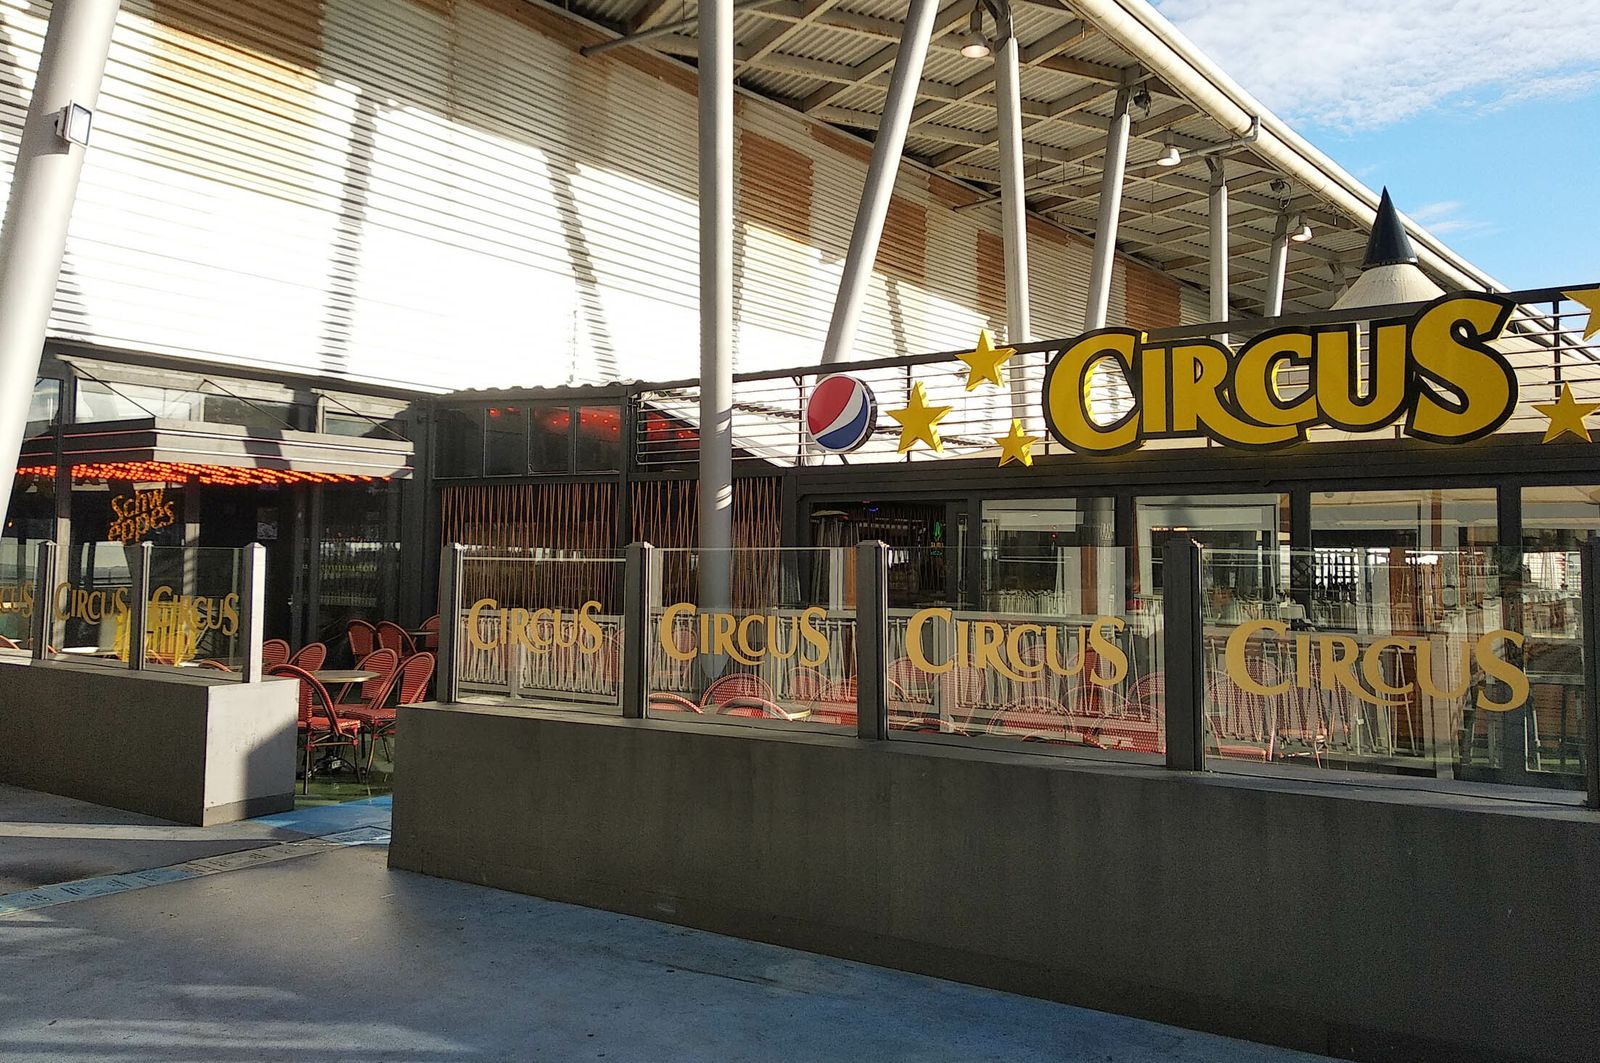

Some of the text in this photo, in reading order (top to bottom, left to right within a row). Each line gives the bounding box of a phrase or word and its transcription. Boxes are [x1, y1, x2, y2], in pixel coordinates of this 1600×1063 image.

[1046, 293, 1516, 454] CIRCUS
[54, 582, 129, 626] CIRCUS
[151, 585, 240, 636] CIRCUS
[467, 598, 602, 655] CIRCUS
[661, 602, 830, 668] CIRCUS
[906, 606, 1129, 687] CIRCUS
[1224, 619, 1531, 712] CIRCUS
